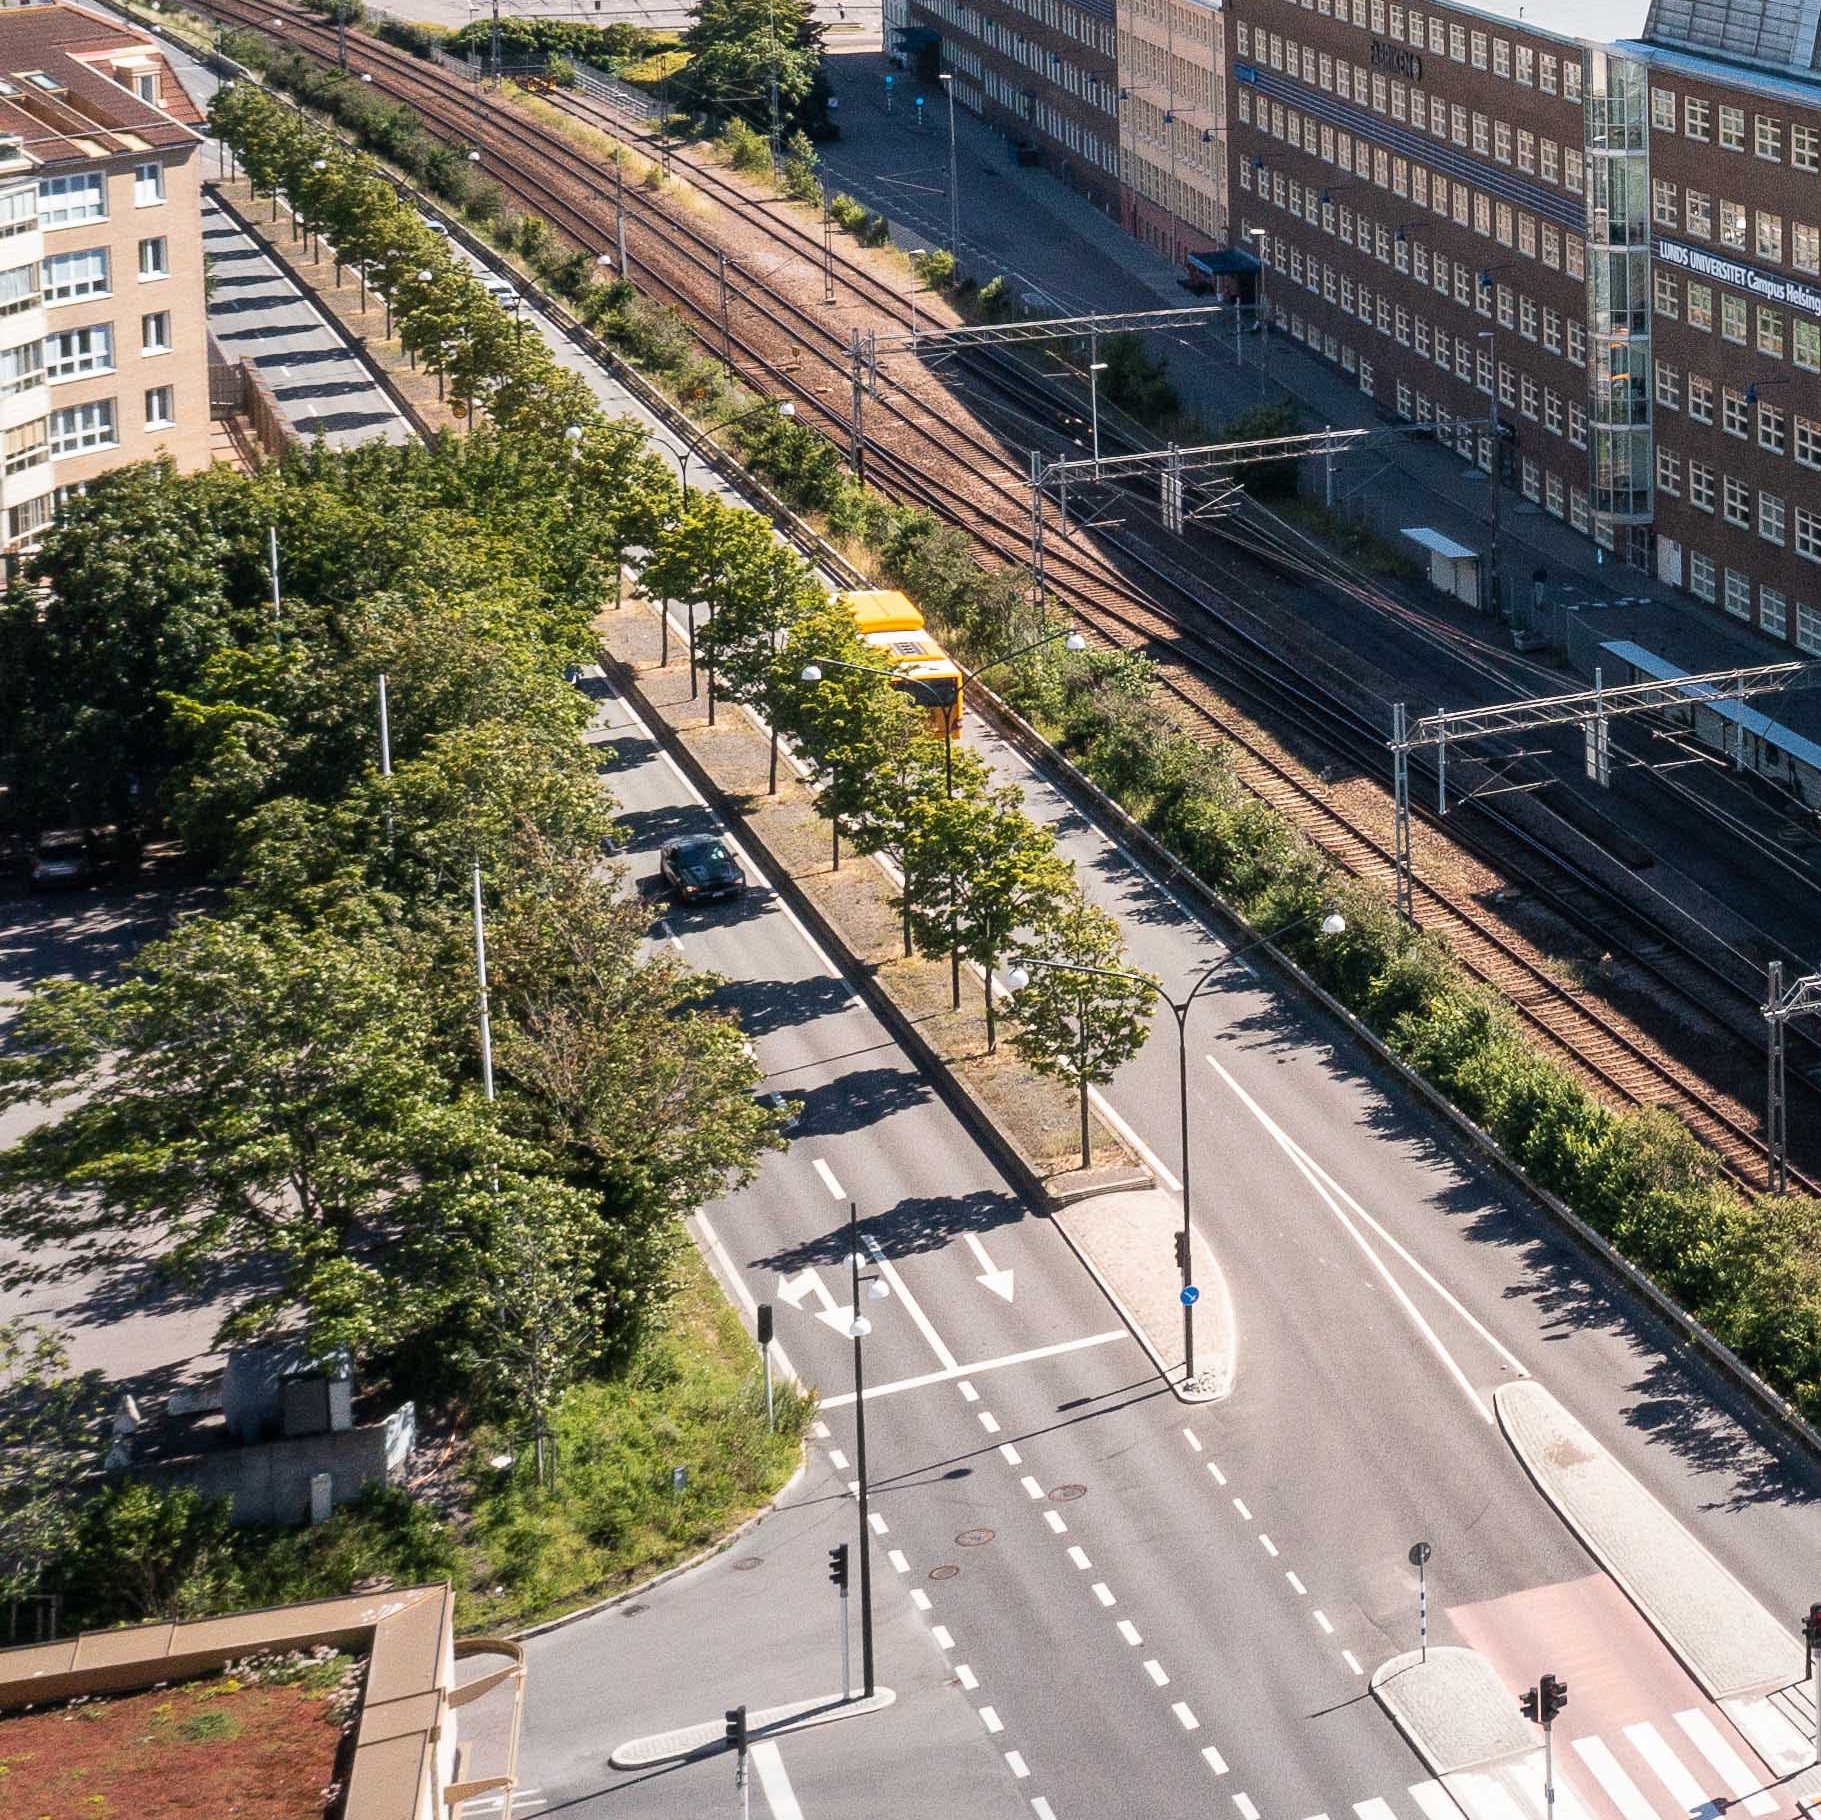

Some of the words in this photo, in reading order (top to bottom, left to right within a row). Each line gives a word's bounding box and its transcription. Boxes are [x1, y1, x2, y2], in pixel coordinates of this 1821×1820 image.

[1659, 241, 1688, 265] LUNDS
[1689, 252, 1748, 287] UNIVERSITET
[1747, 271, 1785, 300] Campus
